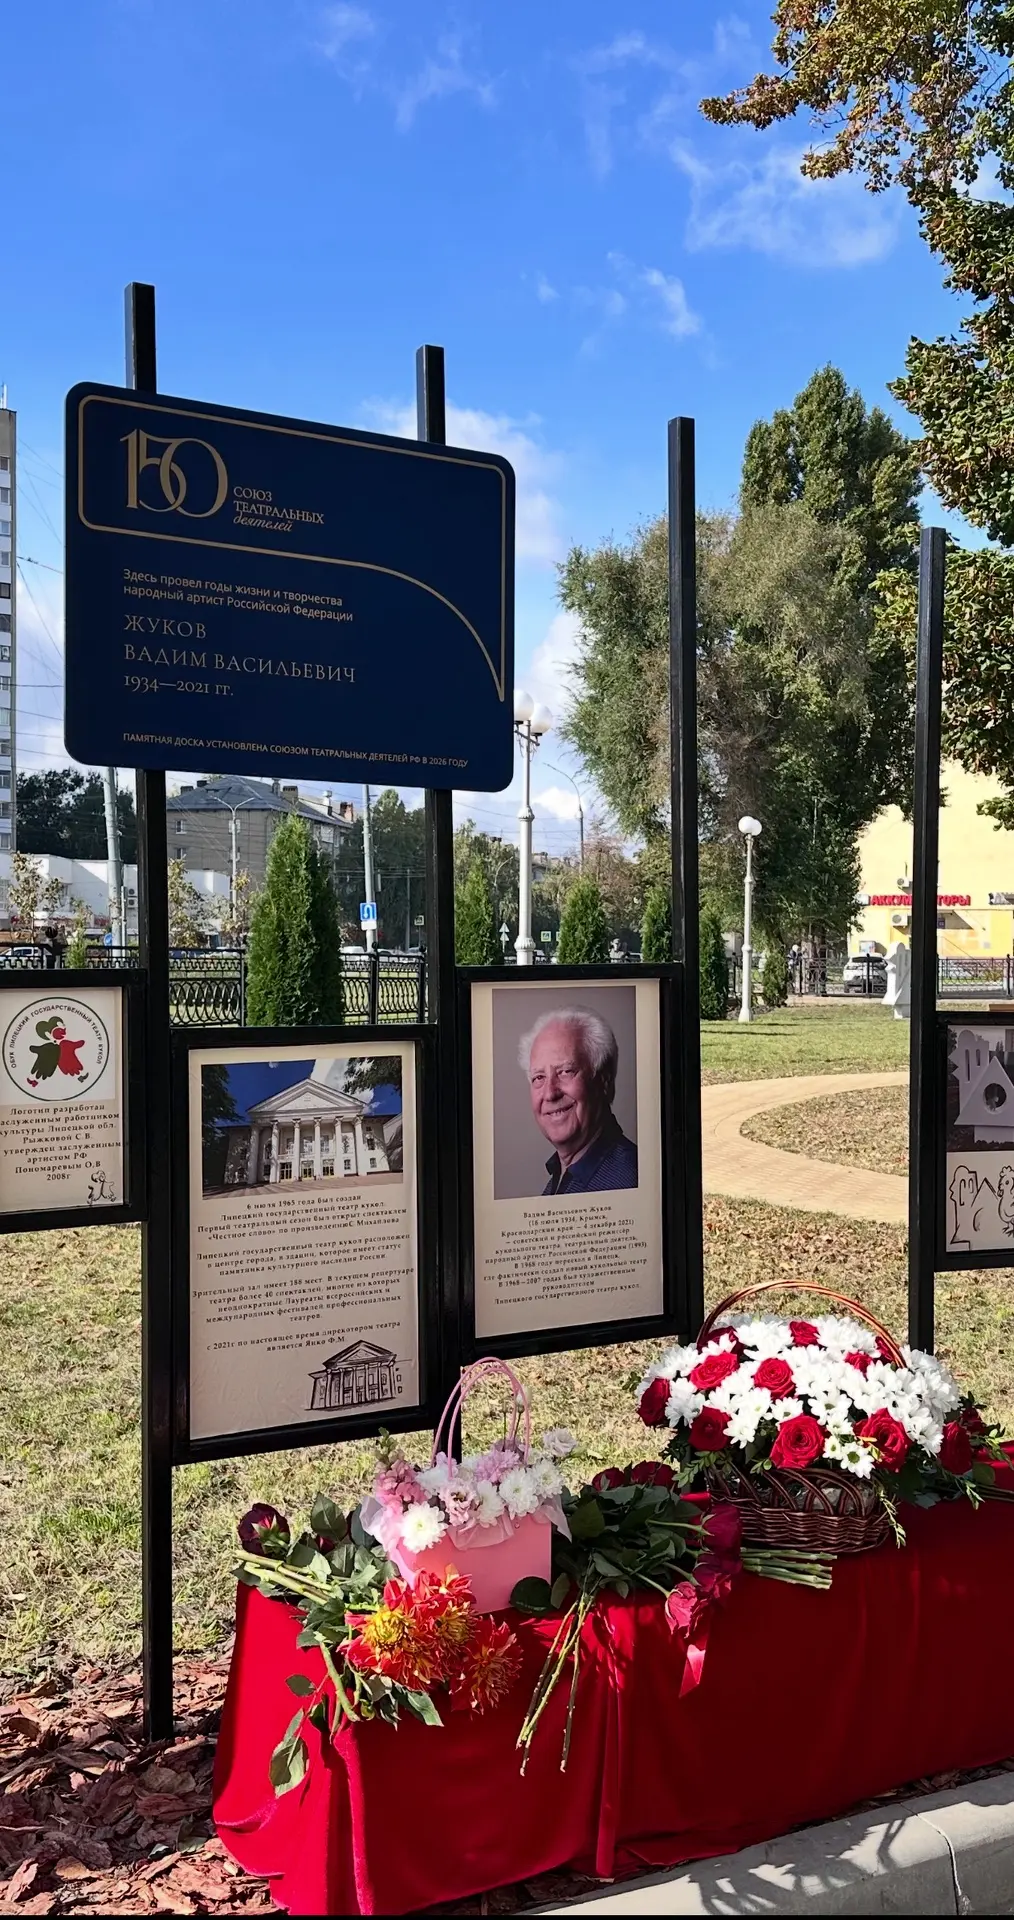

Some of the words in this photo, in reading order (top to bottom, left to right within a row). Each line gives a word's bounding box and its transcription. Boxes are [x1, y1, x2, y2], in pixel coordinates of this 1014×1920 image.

[120, 429, 228, 518] 150
[233, 486, 272, 501] СОЮЗ
[233, 501, 325, 524] ТЕАТРАЛЬНЫХ
[233, 511, 293, 532] деятелей
[123, 568, 157, 583] Здесь
[161, 575, 202, 589] провел
[205, 581, 232, 593] годы
[235, 585, 271, 597] жизни
[273, 589, 280, 598] и
[283, 591, 342, 606] творчества
[124, 586, 183, 601] народный
[187, 593, 223, 606] артист
[228, 597, 290, 614] Российской
[293, 605, 353, 622] Федерации
[124, 615, 206, 639] ЖУКОВ
[124, 645, 207, 668] ВАДИМ
[214, 654, 356, 683] ВАСИЛЬЕВИЧ
[215, 684, 234, 695] гг.
[123, 733, 173, 745] ПАМЯТНАЯ
[174, 737, 204, 747] ДОСКА
[206, 740, 268, 752] УСТАНОВЛЕНА
[270, 745, 309, 755] СОЮЗОМ
[311, 747, 367, 760] ТЕАТРАЛЬНЫХ
[368, 752, 408, 763] ДЕЯТЕЛЕЙ
[409, 755, 421, 763] РФ
[429, 757, 447, 766] 2026
[448, 759, 468, 767] ГОДУ
[871, 894, 971, 907] АККУМТОРЫ
[10, 1016, 30, 1048] ЛИПЕЦКИЙ
[31, 1005, 93, 1023] ГОСУДАРСТВЕННЫЙ
[91, 1021, 102, 1041] ТЕАТР
[53, 1105, 105, 1114] разработан
[0, 1117, 61, 1126] аслуженным
[64, 1113, 119, 1123] работником
[48, 1123, 95, 1132] Липецкой
[23, 1135, 72, 1144] Рыжковой
[3, 1146, 55, 1157] утвержден
[58, 1141, 121, 1150] заслуженным
[27, 1155, 70, 1164] артистом
[15, 1163, 82, 1173] Пономаревым
